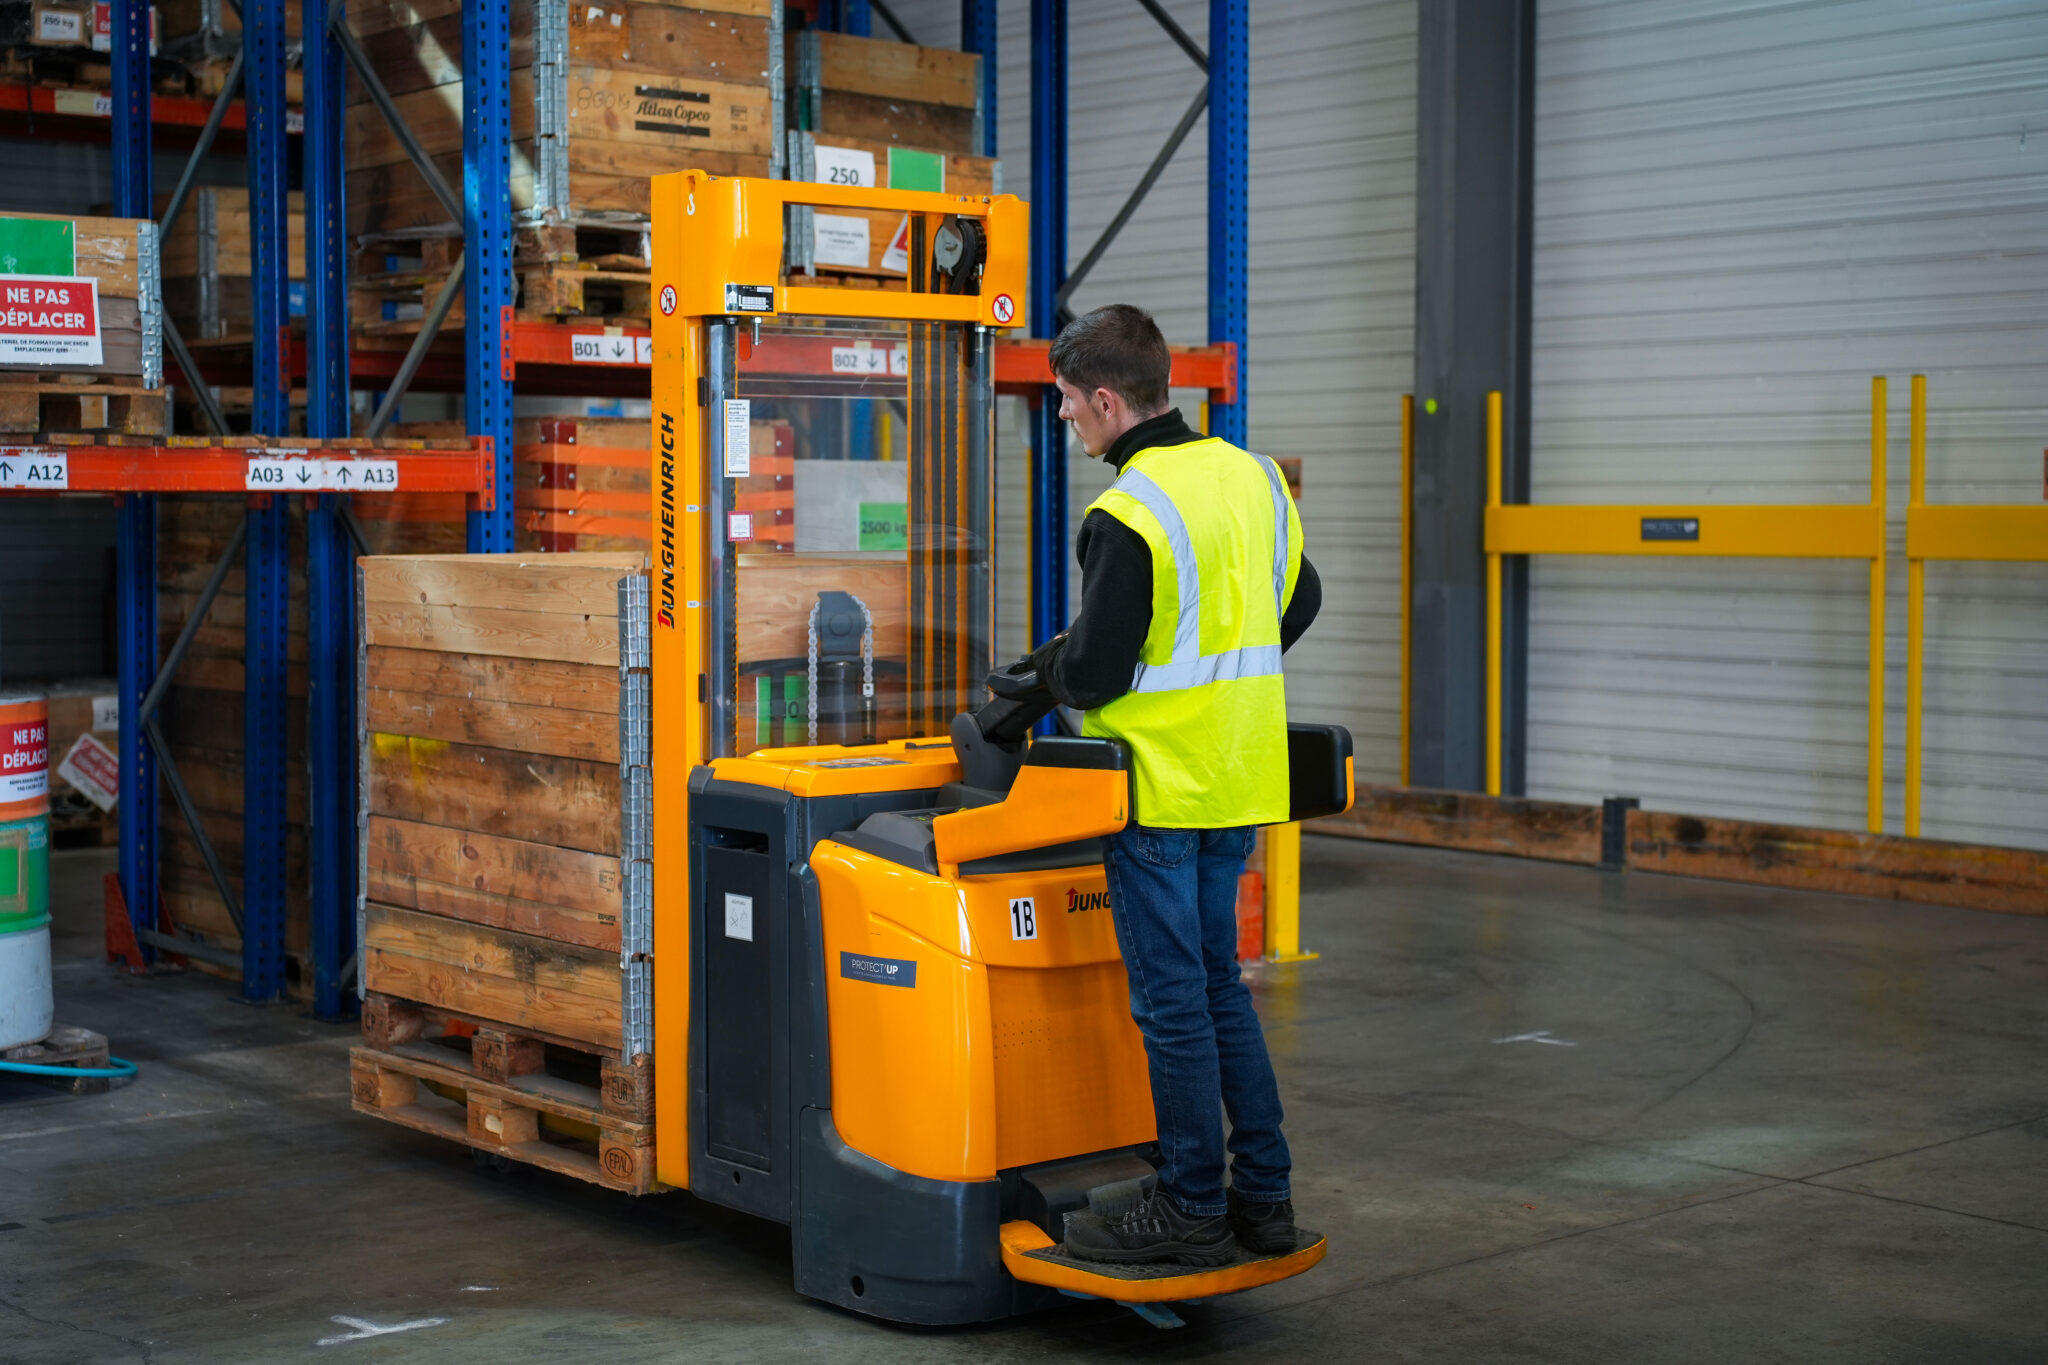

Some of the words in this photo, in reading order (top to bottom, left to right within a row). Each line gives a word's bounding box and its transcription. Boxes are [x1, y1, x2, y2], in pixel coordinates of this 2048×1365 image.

[636, 100, 673, 118] Atlas
[674, 104, 710, 123] Copco
[830, 166, 859, 185] 250
[7, 287, 30, 304] NE
[34, 288, 70, 305] PAS
[574, 342, 601, 357] B01
[834, 354, 858, 368] B02
[28, 464, 64, 480] A12
[251, 467, 284, 483] A03
[364, 468, 395, 483] A13
[660, 412, 675, 630] JUNGHEINRICH
[13, 729, 28, 745] NE
[31, 726, 45, 743] PAS
[1012, 900, 1034, 937] 1B
[608, 1152, 631, 1175] EPAL
